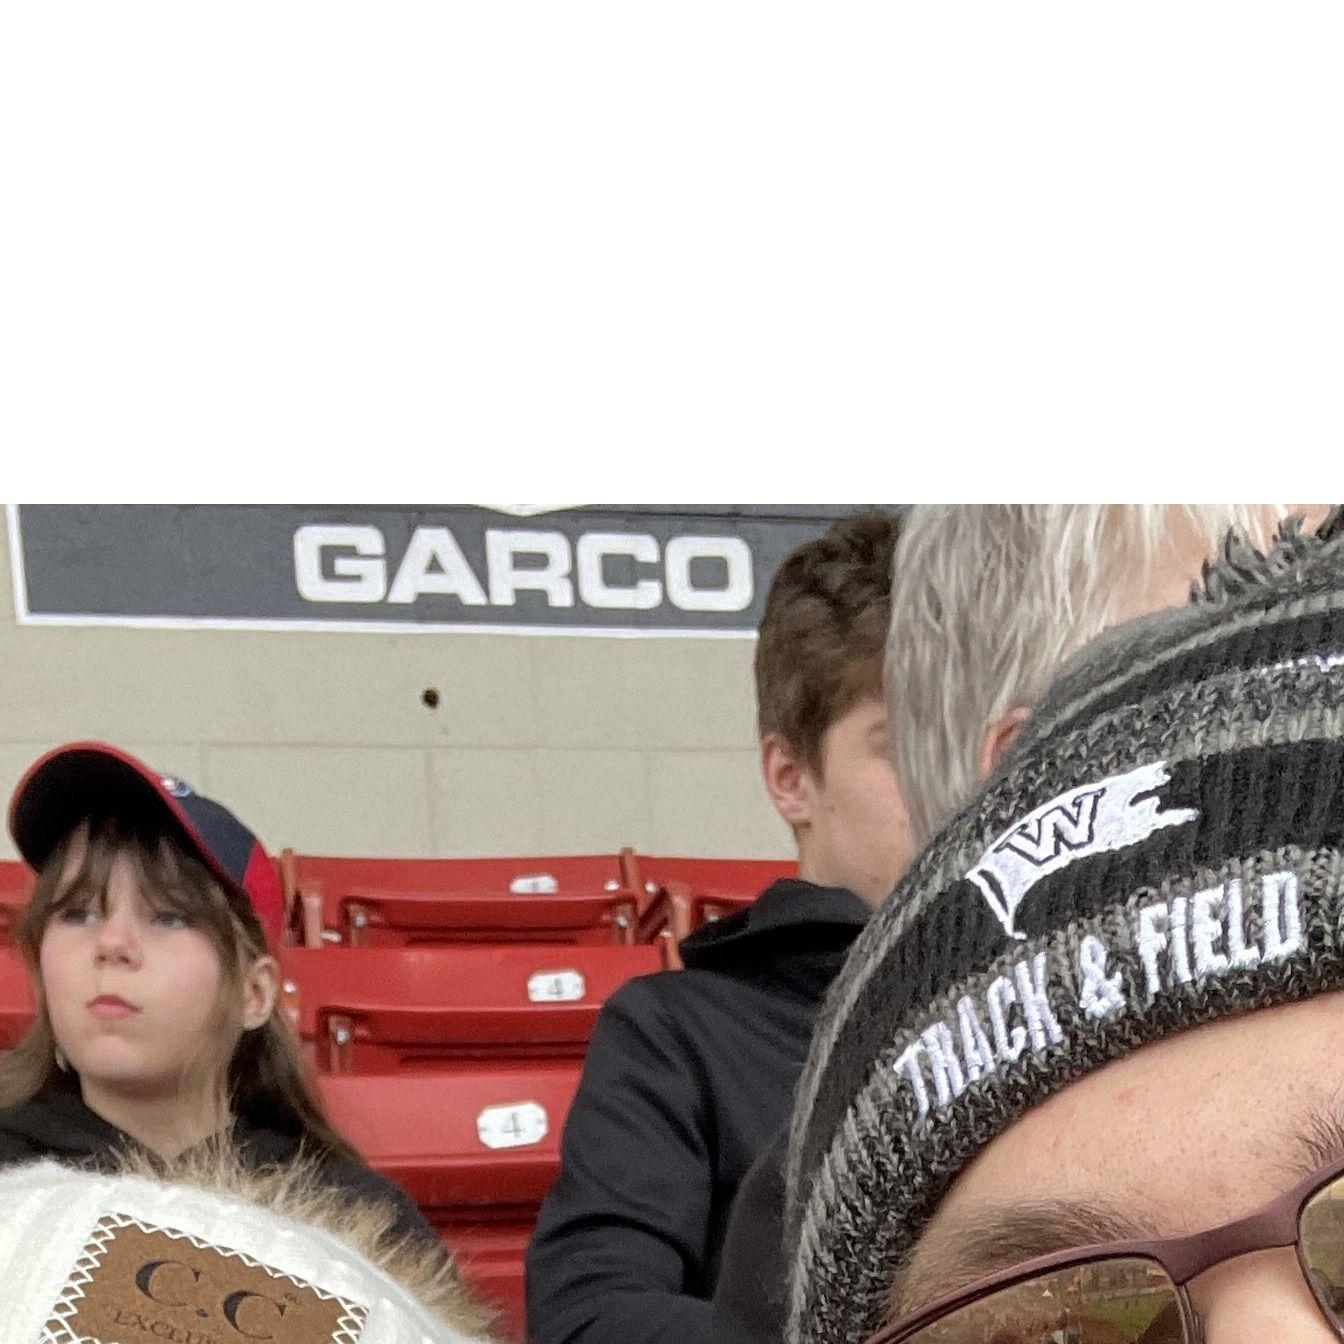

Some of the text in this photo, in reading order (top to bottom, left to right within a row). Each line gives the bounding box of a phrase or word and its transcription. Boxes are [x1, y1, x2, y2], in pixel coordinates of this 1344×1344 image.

[293, 523, 755, 612] GARCO
[893, 870, 1304, 1117] TRACK & FIELD
